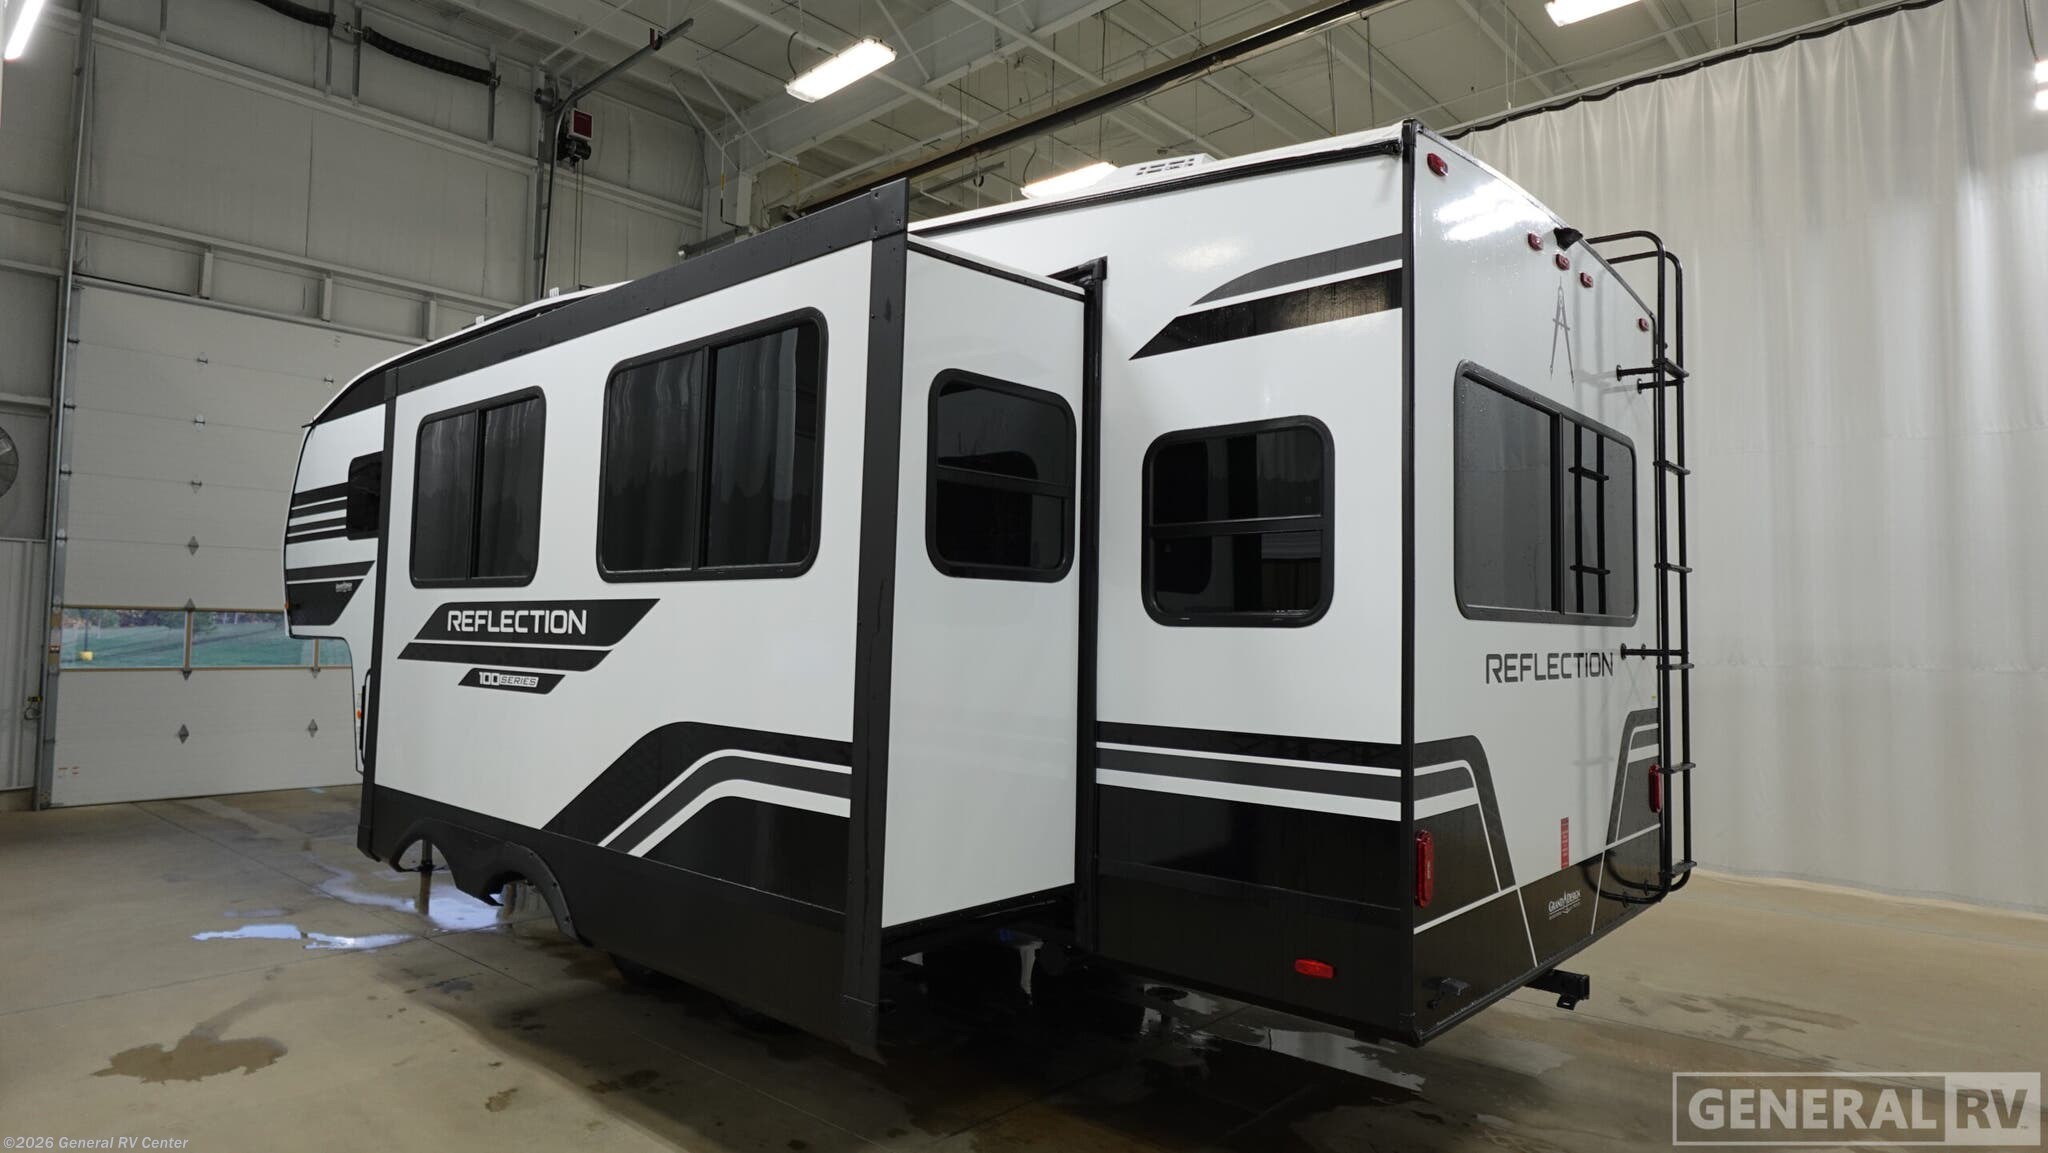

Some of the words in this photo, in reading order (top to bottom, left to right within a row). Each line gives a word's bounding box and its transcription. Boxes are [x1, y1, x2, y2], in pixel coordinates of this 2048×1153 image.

[447, 609, 587, 635] REFLECTION
[479, 671, 500, 686] 100
[500, 675, 538, 687] SERIES
[1486, 652, 1614, 684] REFLECTION
